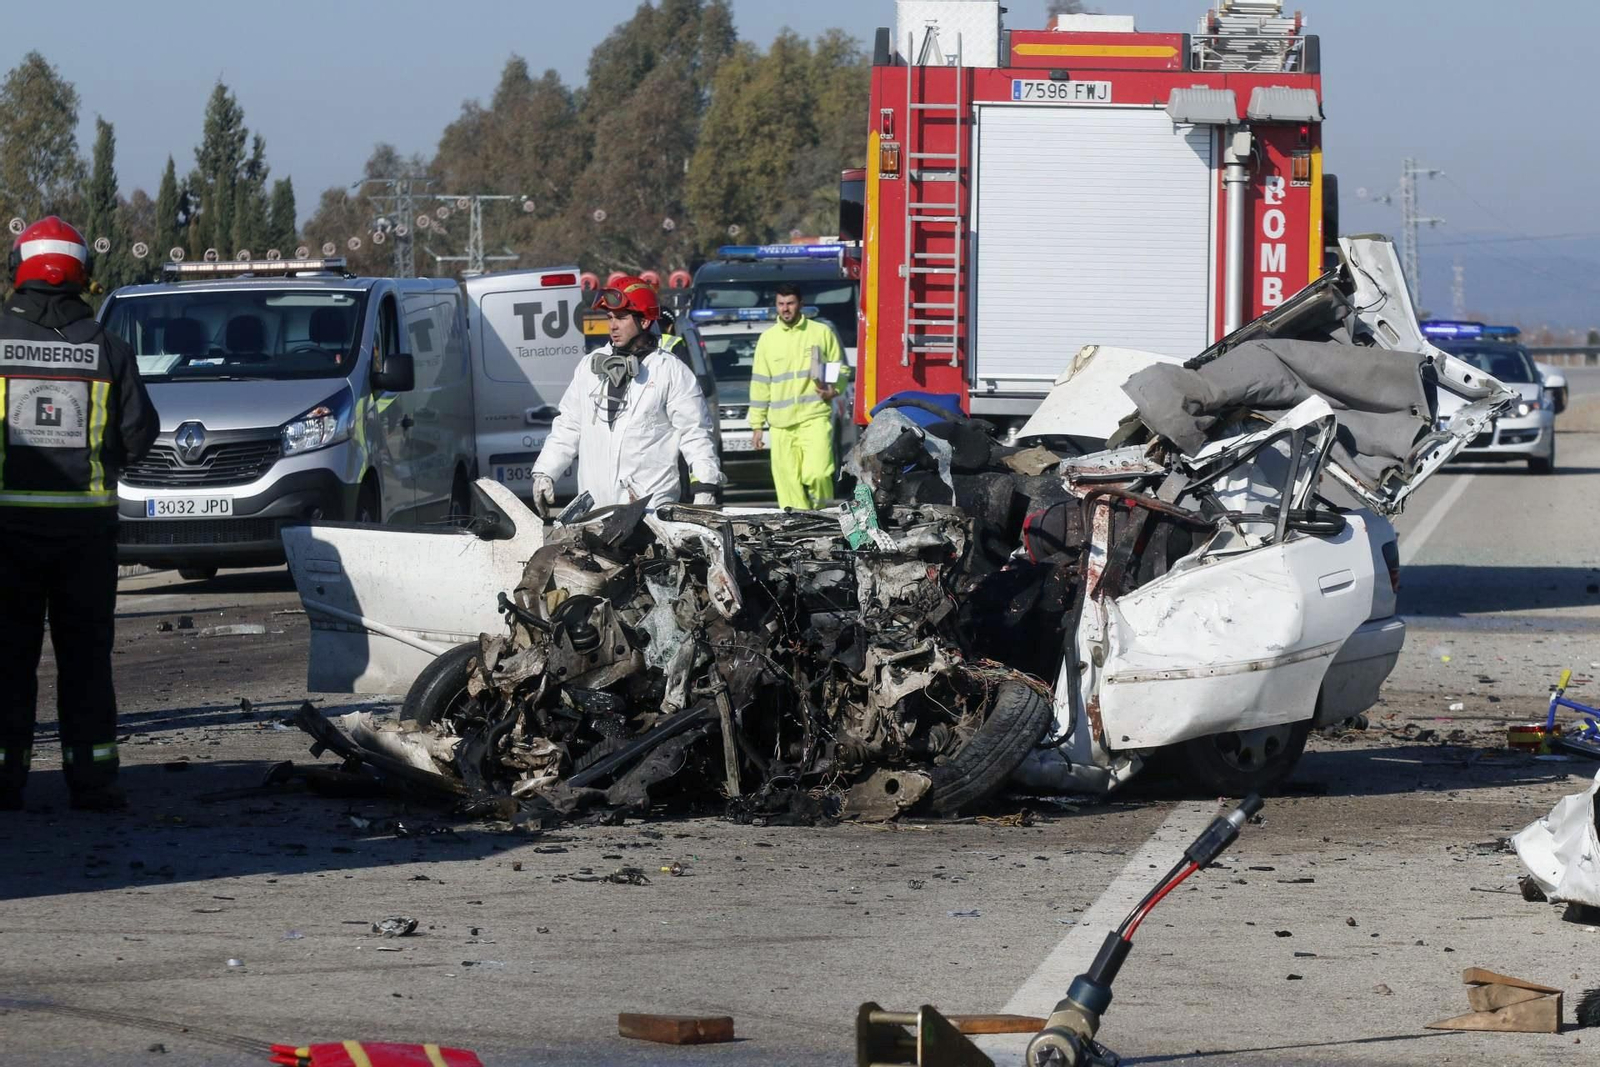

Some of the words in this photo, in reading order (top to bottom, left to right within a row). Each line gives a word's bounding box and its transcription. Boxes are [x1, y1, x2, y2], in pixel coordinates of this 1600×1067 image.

[1024, 83, 1068, 99] 7596
[1075, 84, 1107, 100] FWJ
[1260, 176, 1286, 314] BOMB
[4, 345, 95, 364] BOMBEROS
[516, 345, 579, 358] Tanatorios
[506, 466, 533, 481] 303
[157, 500, 195, 514] 3032
[201, 499, 229, 514] JPD
